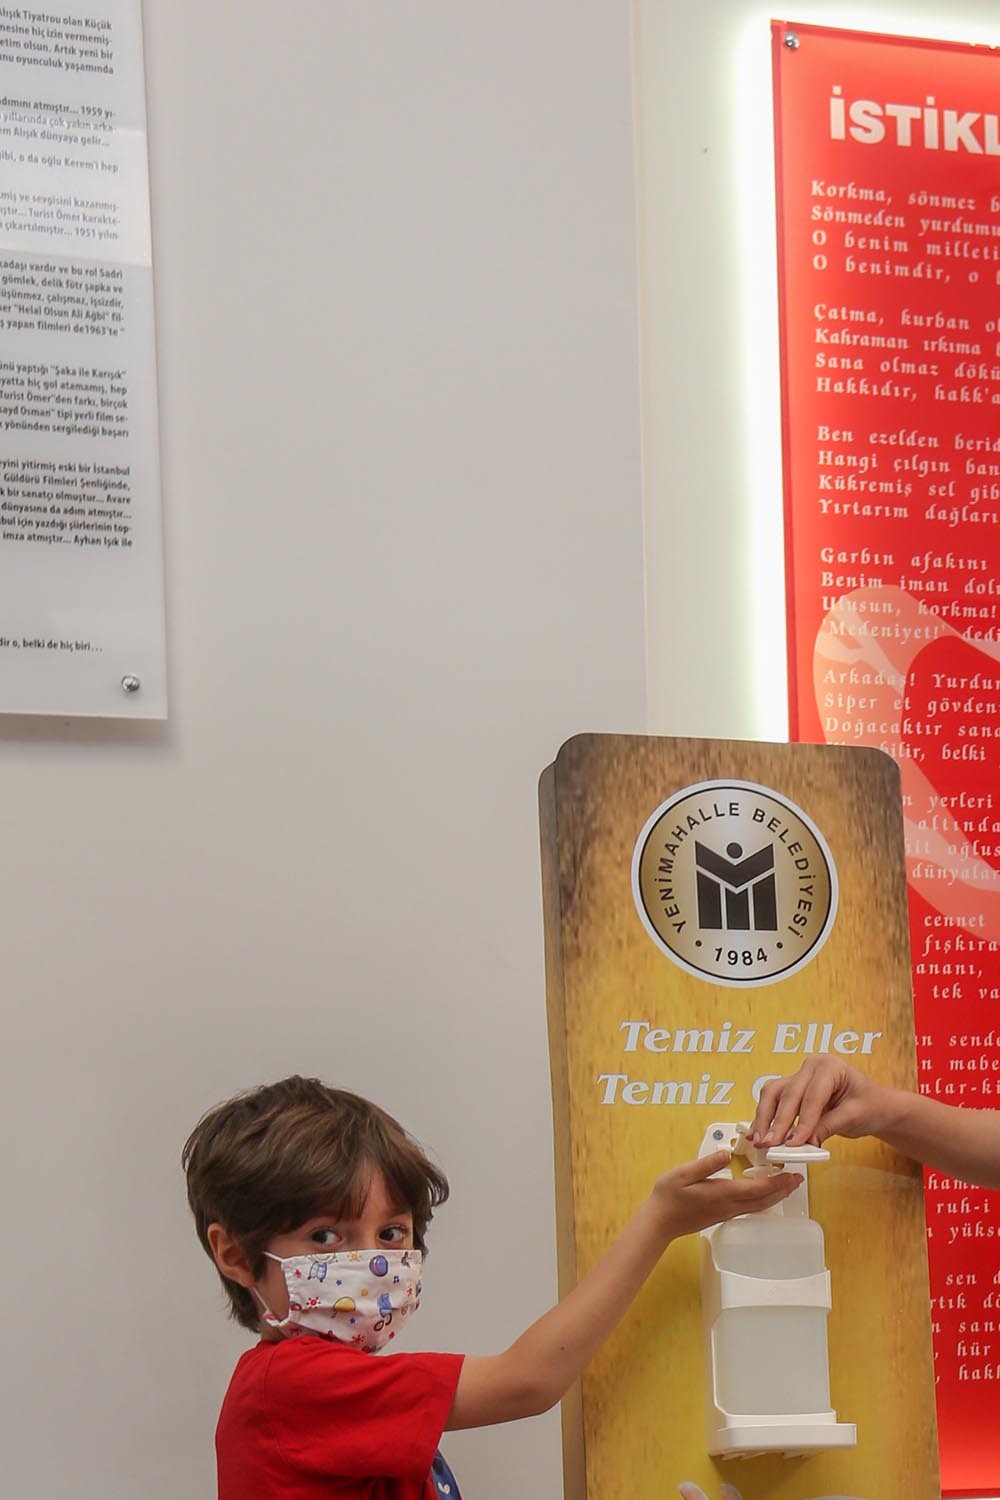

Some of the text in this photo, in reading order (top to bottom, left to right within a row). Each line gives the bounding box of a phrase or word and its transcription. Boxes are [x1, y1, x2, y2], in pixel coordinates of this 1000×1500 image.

[811, 179, 892, 205] Korkma,
[908, 191, 975, 210] sönmez
[811, 204, 905, 228] Sönmeden
[812, 229, 827, 246] O
[844, 230, 908, 252] benim
[812, 254, 828, 270] O
[845, 255, 950, 282] benimdir,
[968, 271, 979, 283] o
[814, 303, 884, 325] Çatma,
[901, 308, 969, 330] kurban
[815, 327, 909, 350] Kahraman
[923, 335, 981, 355] ırkıma
[815, 352, 864, 370] Sana
[880, 356, 939, 376] olmaz
[816, 376, 917, 401] Hakkıdır,
[817, 425, 854, 442] Ben
[869, 429, 939, 448] ezelden
[818, 449, 878, 474] Hangi
[893, 454, 950, 478] çılgın
[818, 474, 912, 497] Kükremiş
[928, 480, 955, 497] sel
[820, 547, 894, 566] Garbın
[911, 551, 987, 574] afakını
[654, 802, 817, 940] YENİMAHALLE BELEDİYESİ
[713, 946, 769, 967] 1984
[619, 1021, 884, 1055] Temiz Eller
[596, 1073, 733, 1105] Temiz
[936, 1197, 990, 1214] ruh-i
[945, 1274, 977, 1286] sen
